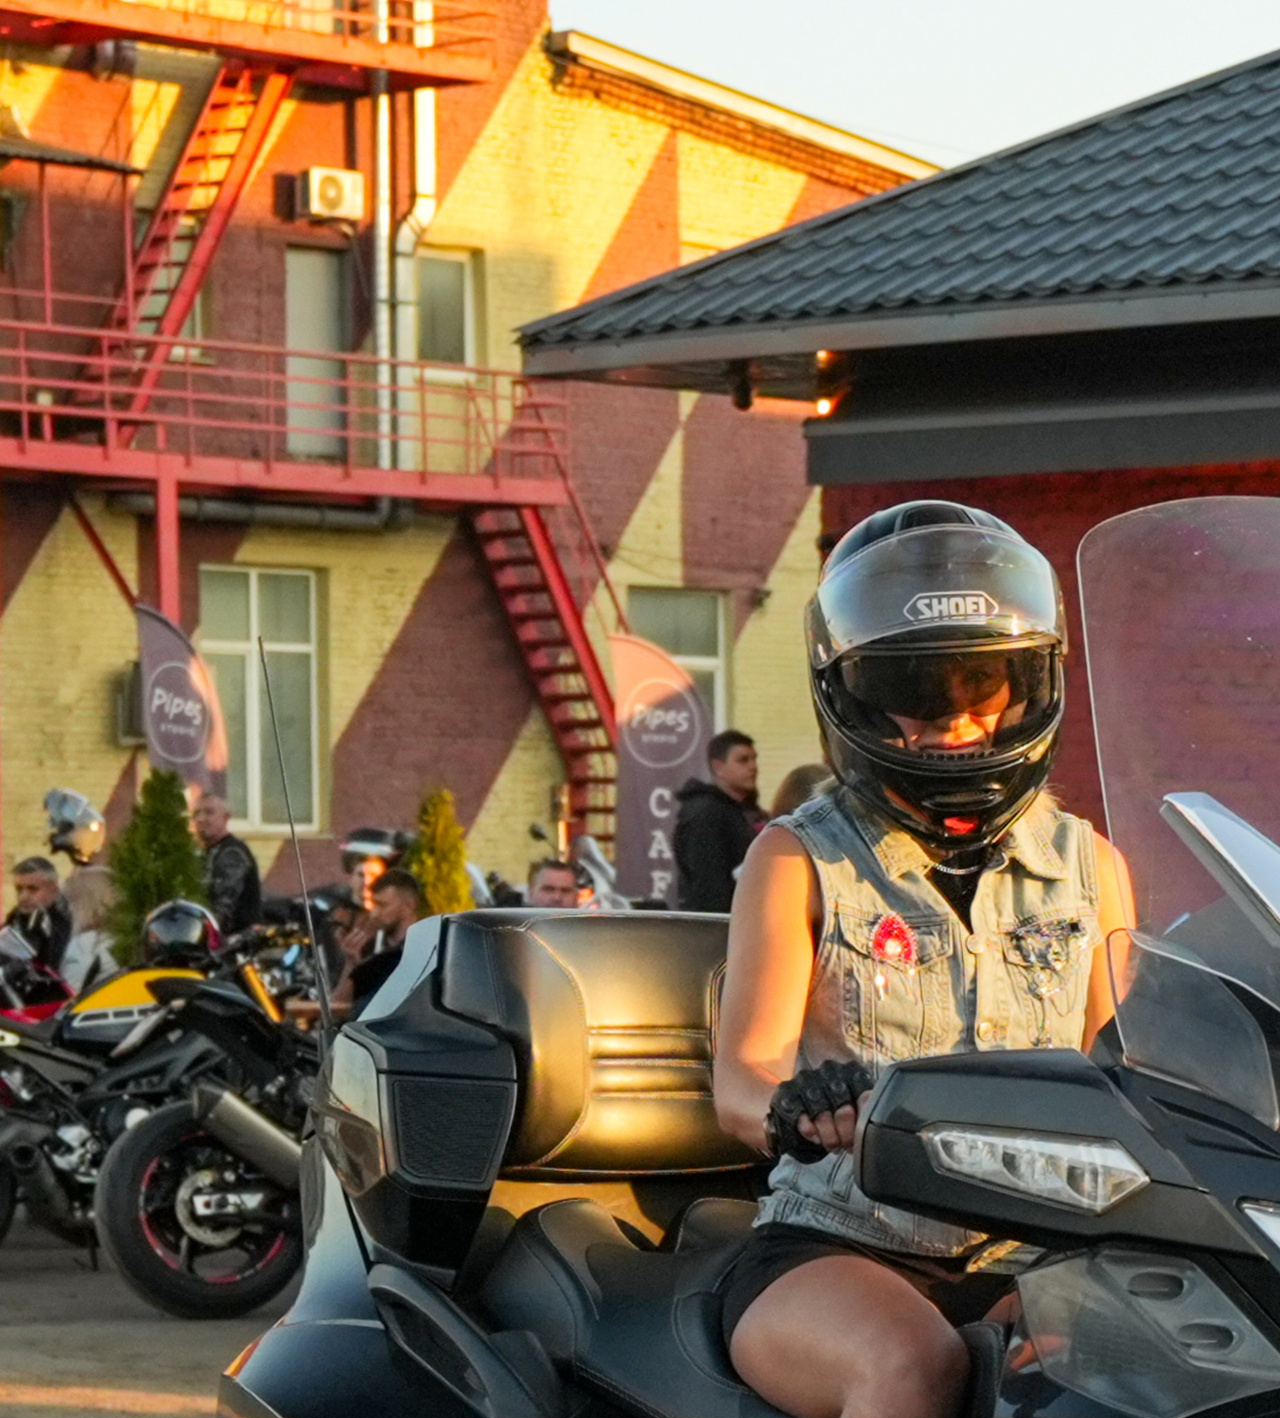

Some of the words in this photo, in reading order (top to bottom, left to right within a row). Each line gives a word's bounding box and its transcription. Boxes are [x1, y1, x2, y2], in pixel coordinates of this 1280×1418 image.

[916, 595, 987, 620] SHOEI
[151, 687, 203, 726] Pipes
[631, 703, 690, 733] Pipes
